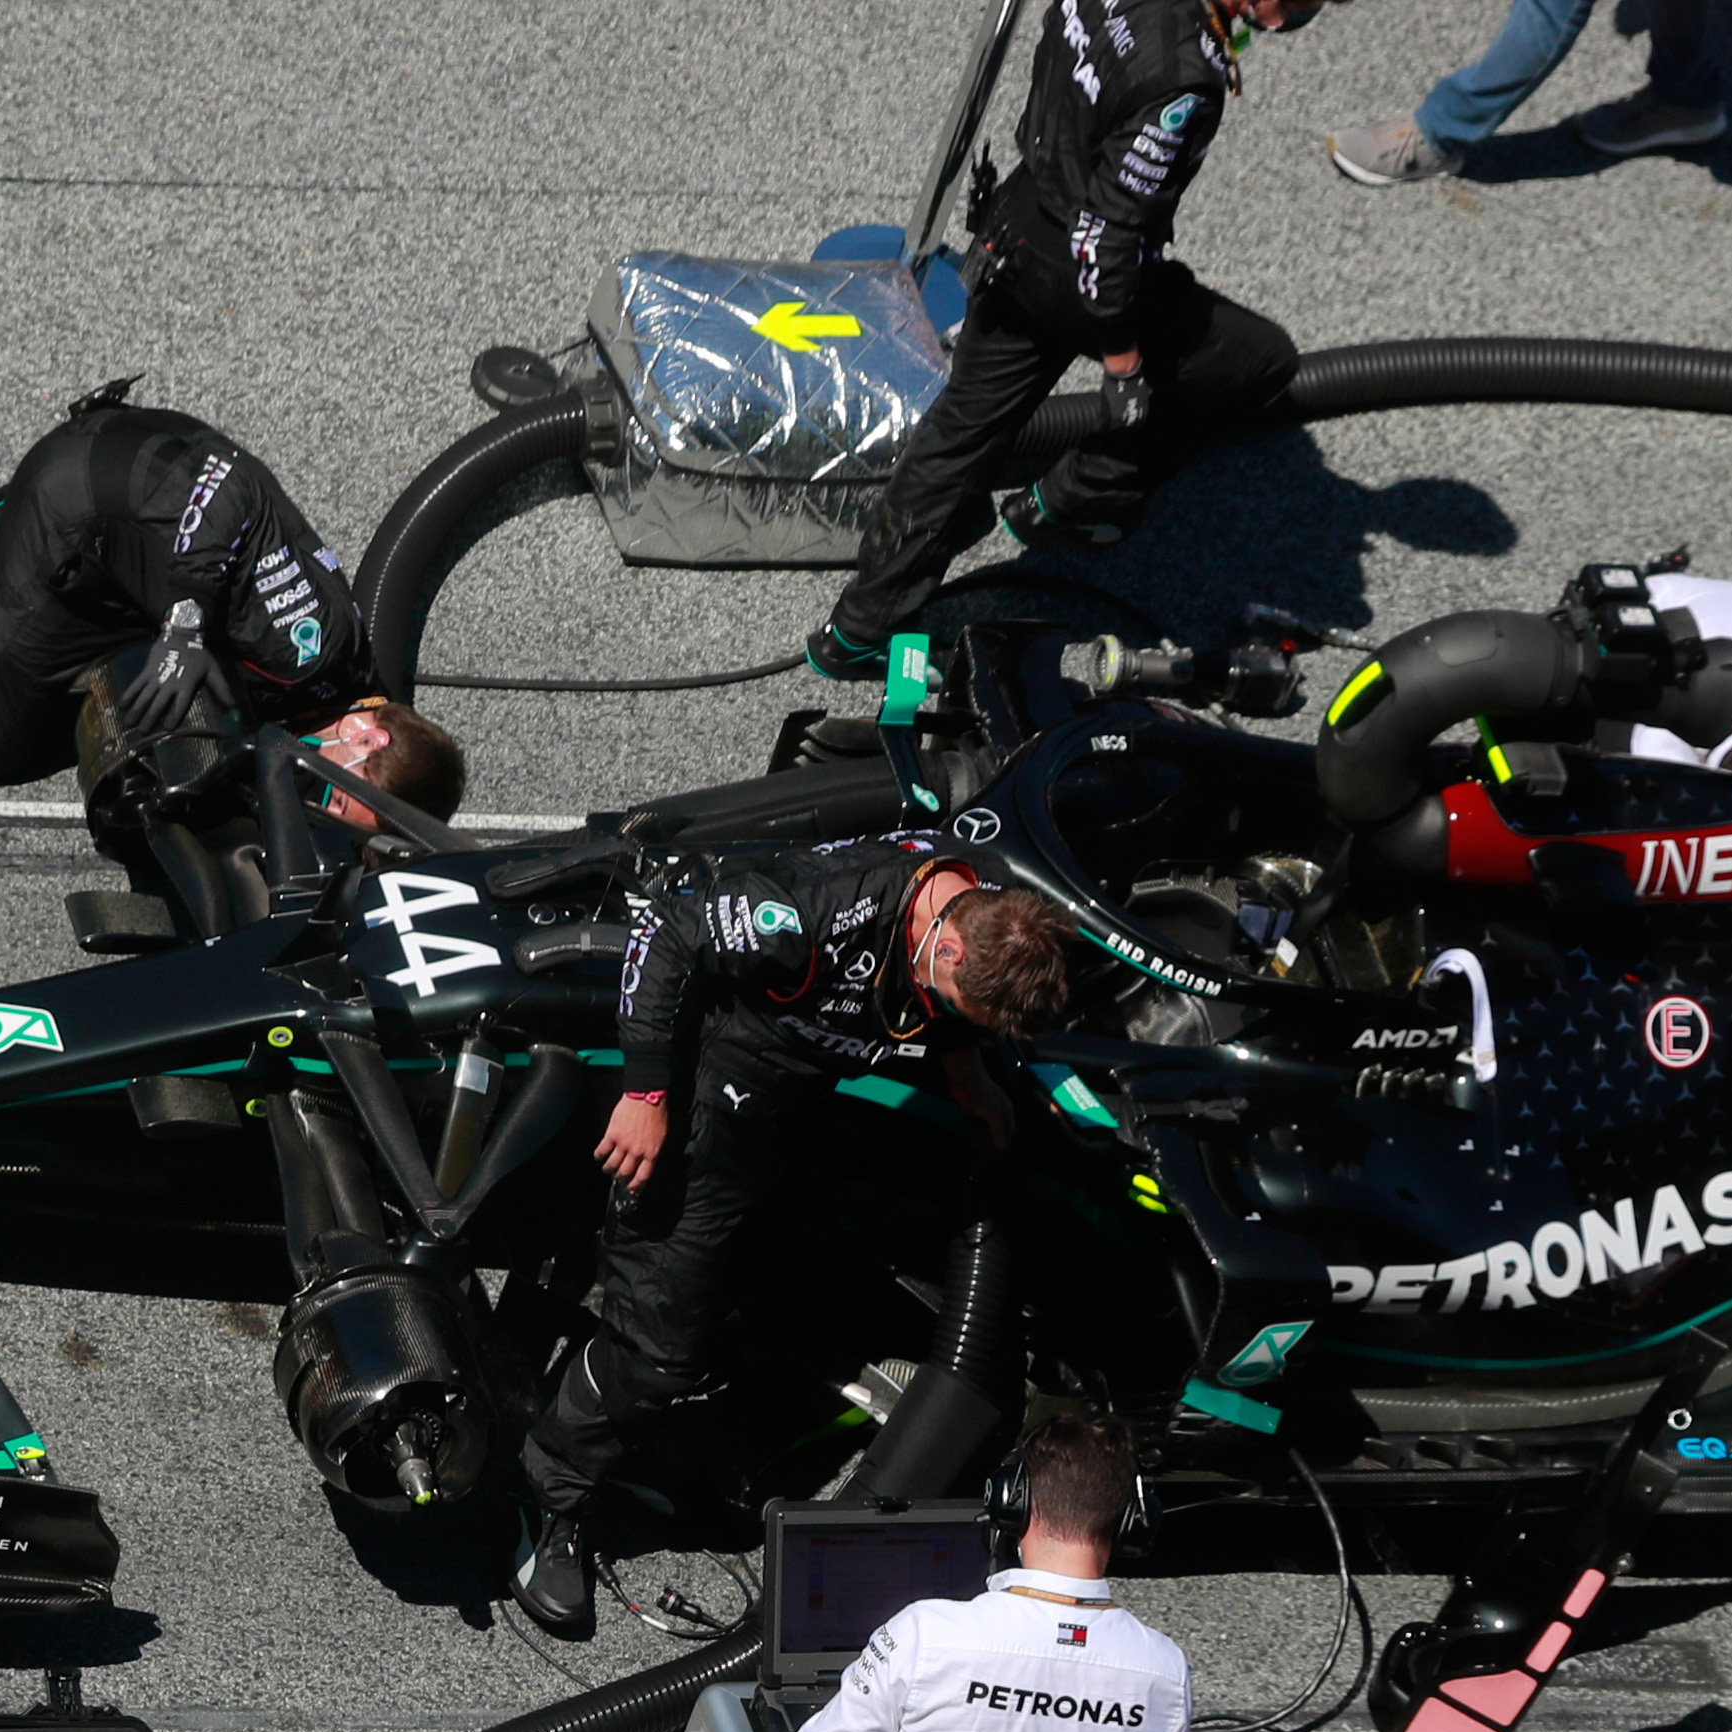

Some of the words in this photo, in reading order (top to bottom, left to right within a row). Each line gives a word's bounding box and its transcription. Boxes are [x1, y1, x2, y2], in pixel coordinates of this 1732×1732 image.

[265, 579, 312, 614] EPSON
[1091, 734, 1128, 752] INEOS
[363, 871, 502, 998] 44
[1105, 932, 1146, 964] END
[1147, 956, 1223, 997] RACISM
[1352, 1024, 1441, 1050] AMD
[1660, 1006, 1693, 1059] E
[1676, 1437, 1728, 1460] EQ
[965, 1680, 1146, 1728] PETRONAS
